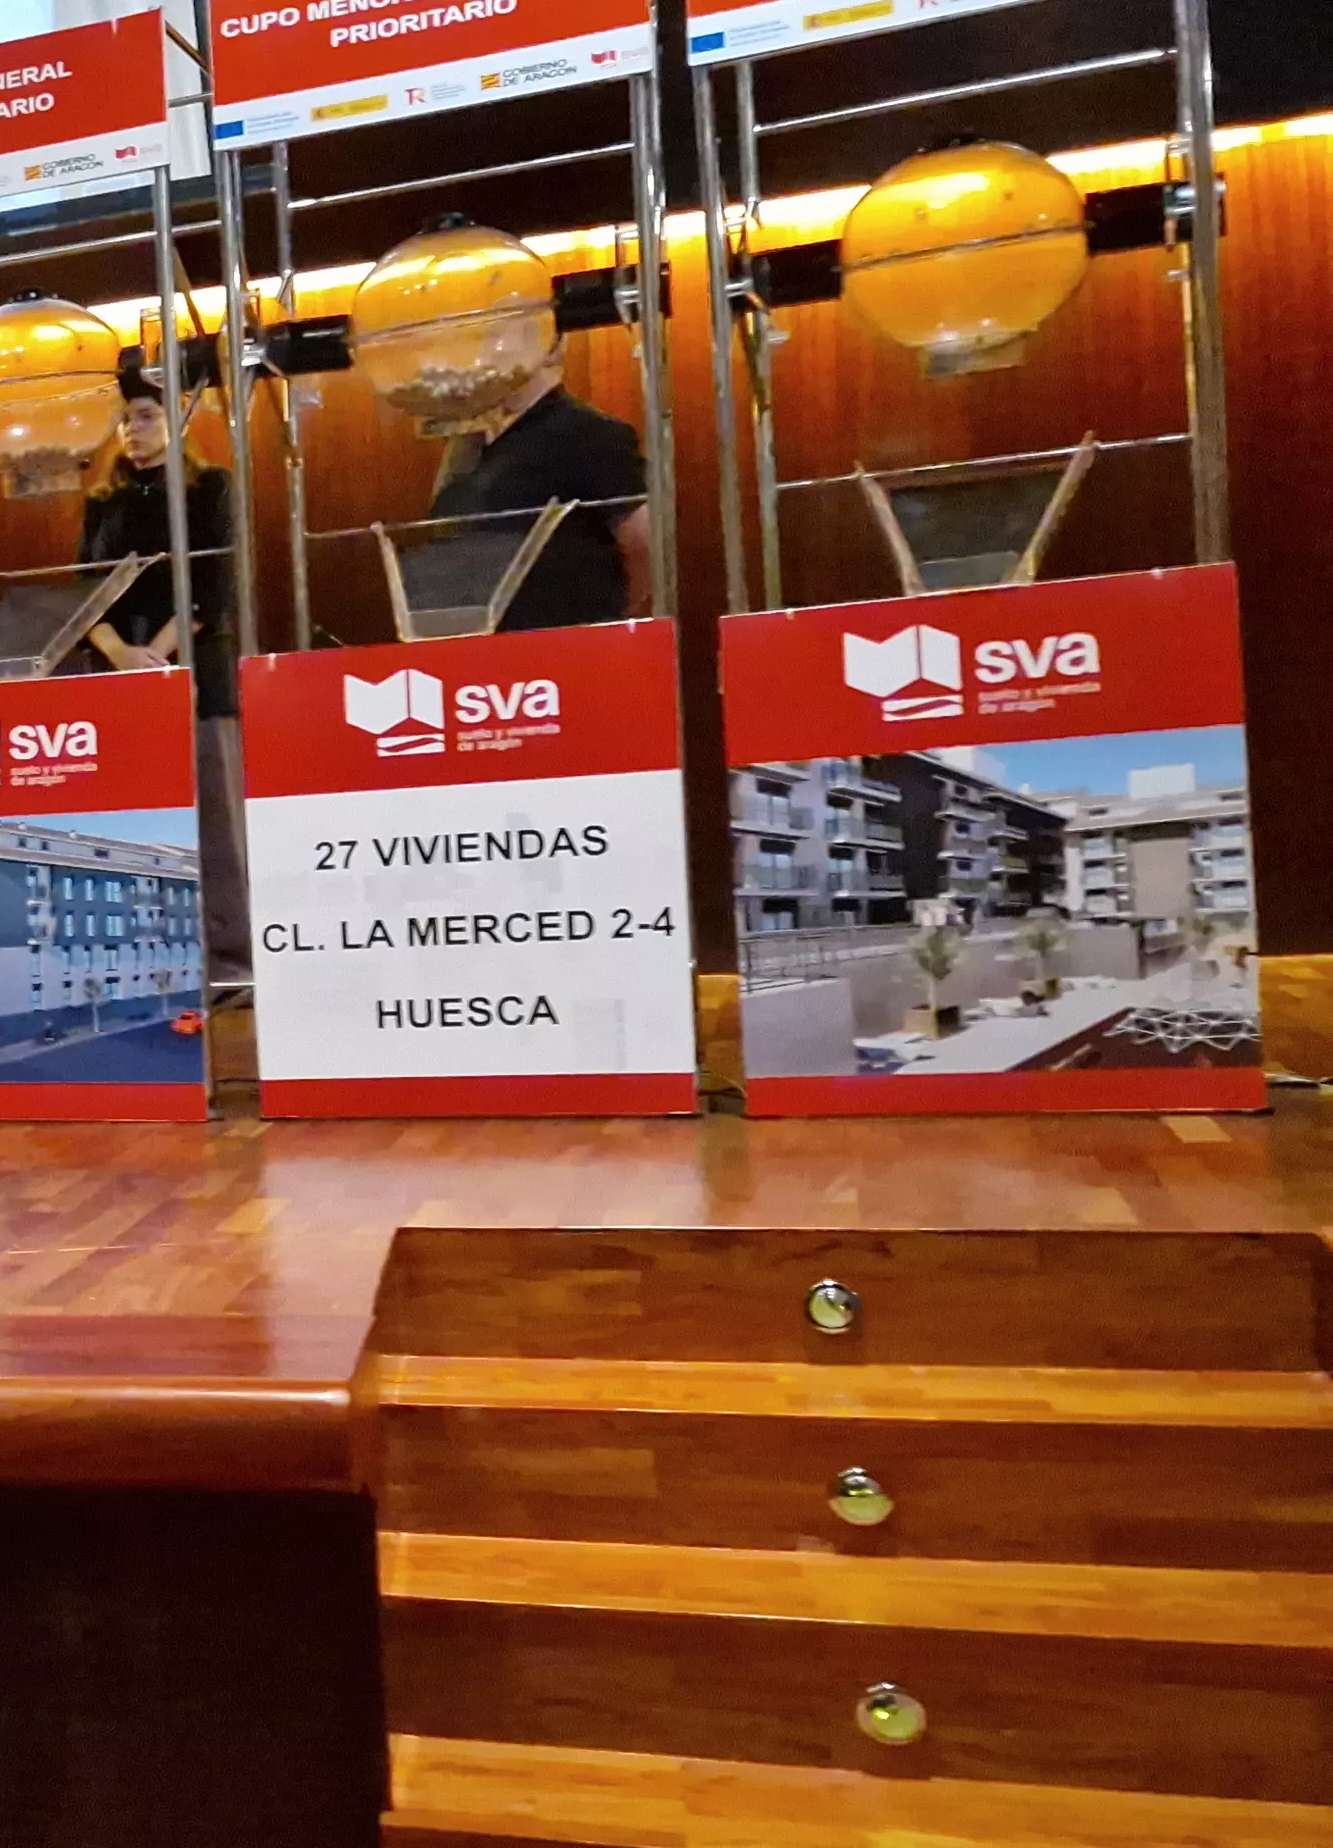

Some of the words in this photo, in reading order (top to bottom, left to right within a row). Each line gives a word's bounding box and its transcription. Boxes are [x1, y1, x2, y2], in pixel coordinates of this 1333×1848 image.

[220, 8, 300, 38] CUPO
[330, 0, 517, 47] PRIORITARIO
[975, 632, 1100, 683] sva
[455, 679, 560, 723] sva
[8, 721, 98, 760] sva
[315, 840, 358, 871] 27
[372, 825, 607, 867] VIVIENDAS
[263, 923, 324, 953] CL.
[341, 919, 394, 950] LA
[408, 910, 594, 947] MERCED
[612, 906, 675, 939] 2-4
[377, 995, 559, 1029] HUESCA
